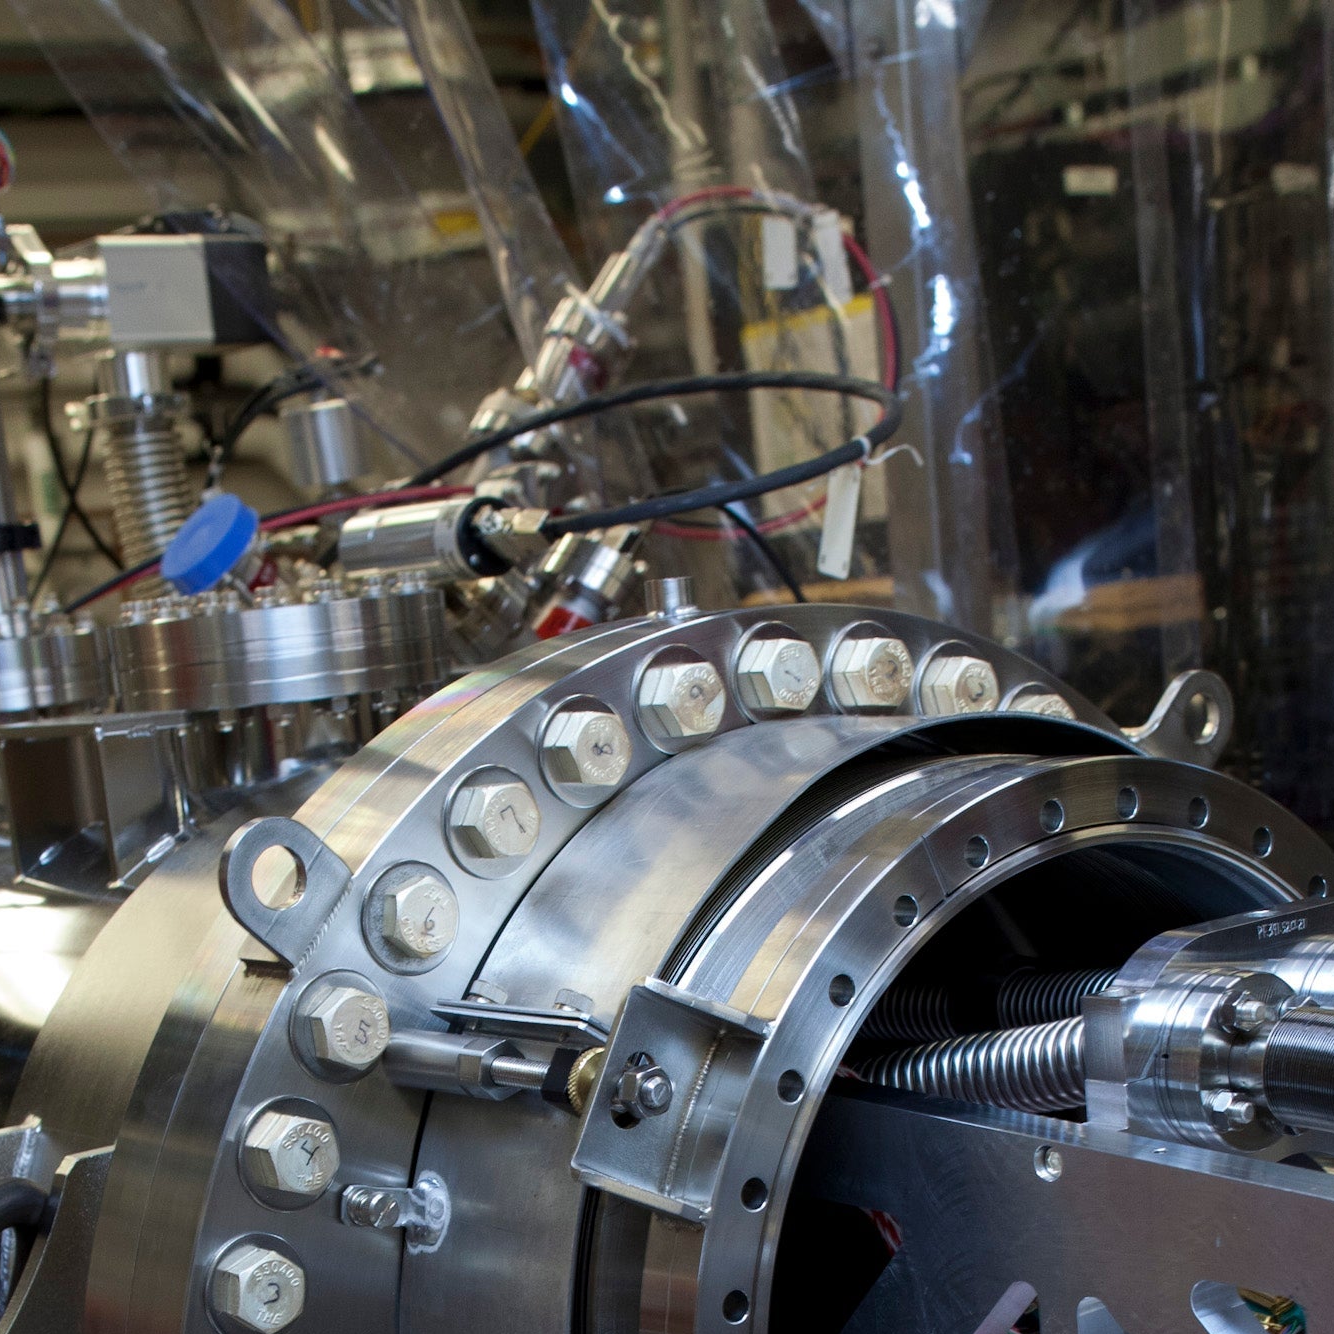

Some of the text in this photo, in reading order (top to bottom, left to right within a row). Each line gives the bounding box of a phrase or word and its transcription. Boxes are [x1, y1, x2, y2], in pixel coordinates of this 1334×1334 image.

[592, 742, 613, 757] 8
[499, 804, 526, 834] 7
[355, 1019, 371, 1045] 5
[300, 1140, 320, 1167] 4
[296, 1171, 325, 1188] THE
[252, 1261, 301, 1288] S30400
[263, 1282, 280, 1306] 3
[255, 1307, 282, 1325] THE
